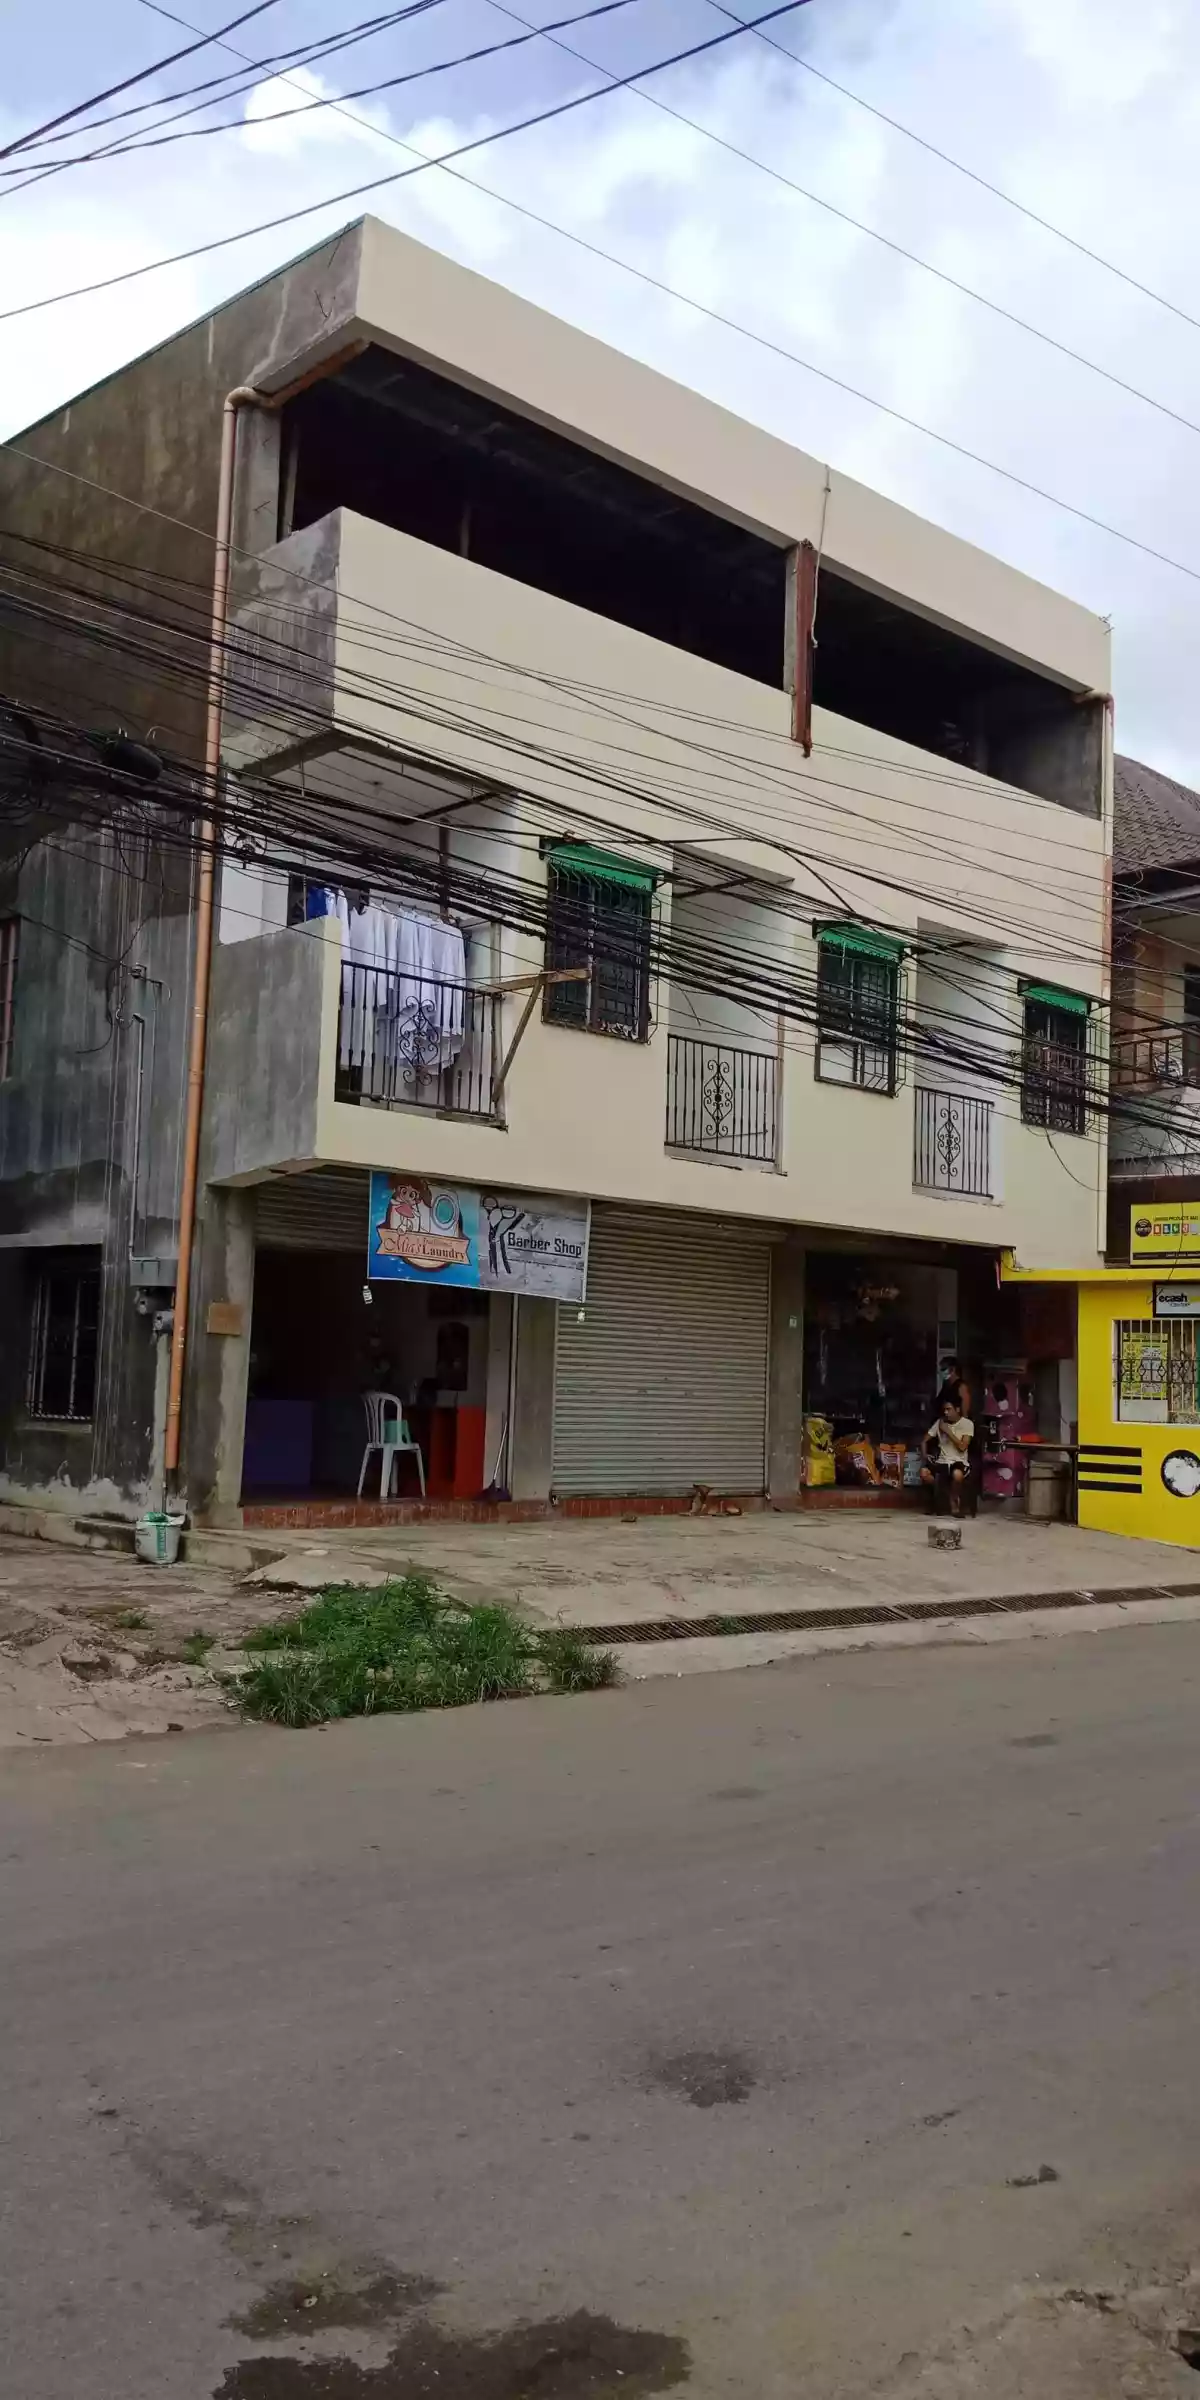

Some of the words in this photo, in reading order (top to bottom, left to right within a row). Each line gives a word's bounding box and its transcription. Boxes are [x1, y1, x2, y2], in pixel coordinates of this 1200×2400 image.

[422, 1242, 466, 1260] Laundry
[507, 1231, 551, 1250] Barber
[554, 1238, 582, 1257] Shop
[1158, 1292, 1188, 1303] ecash
